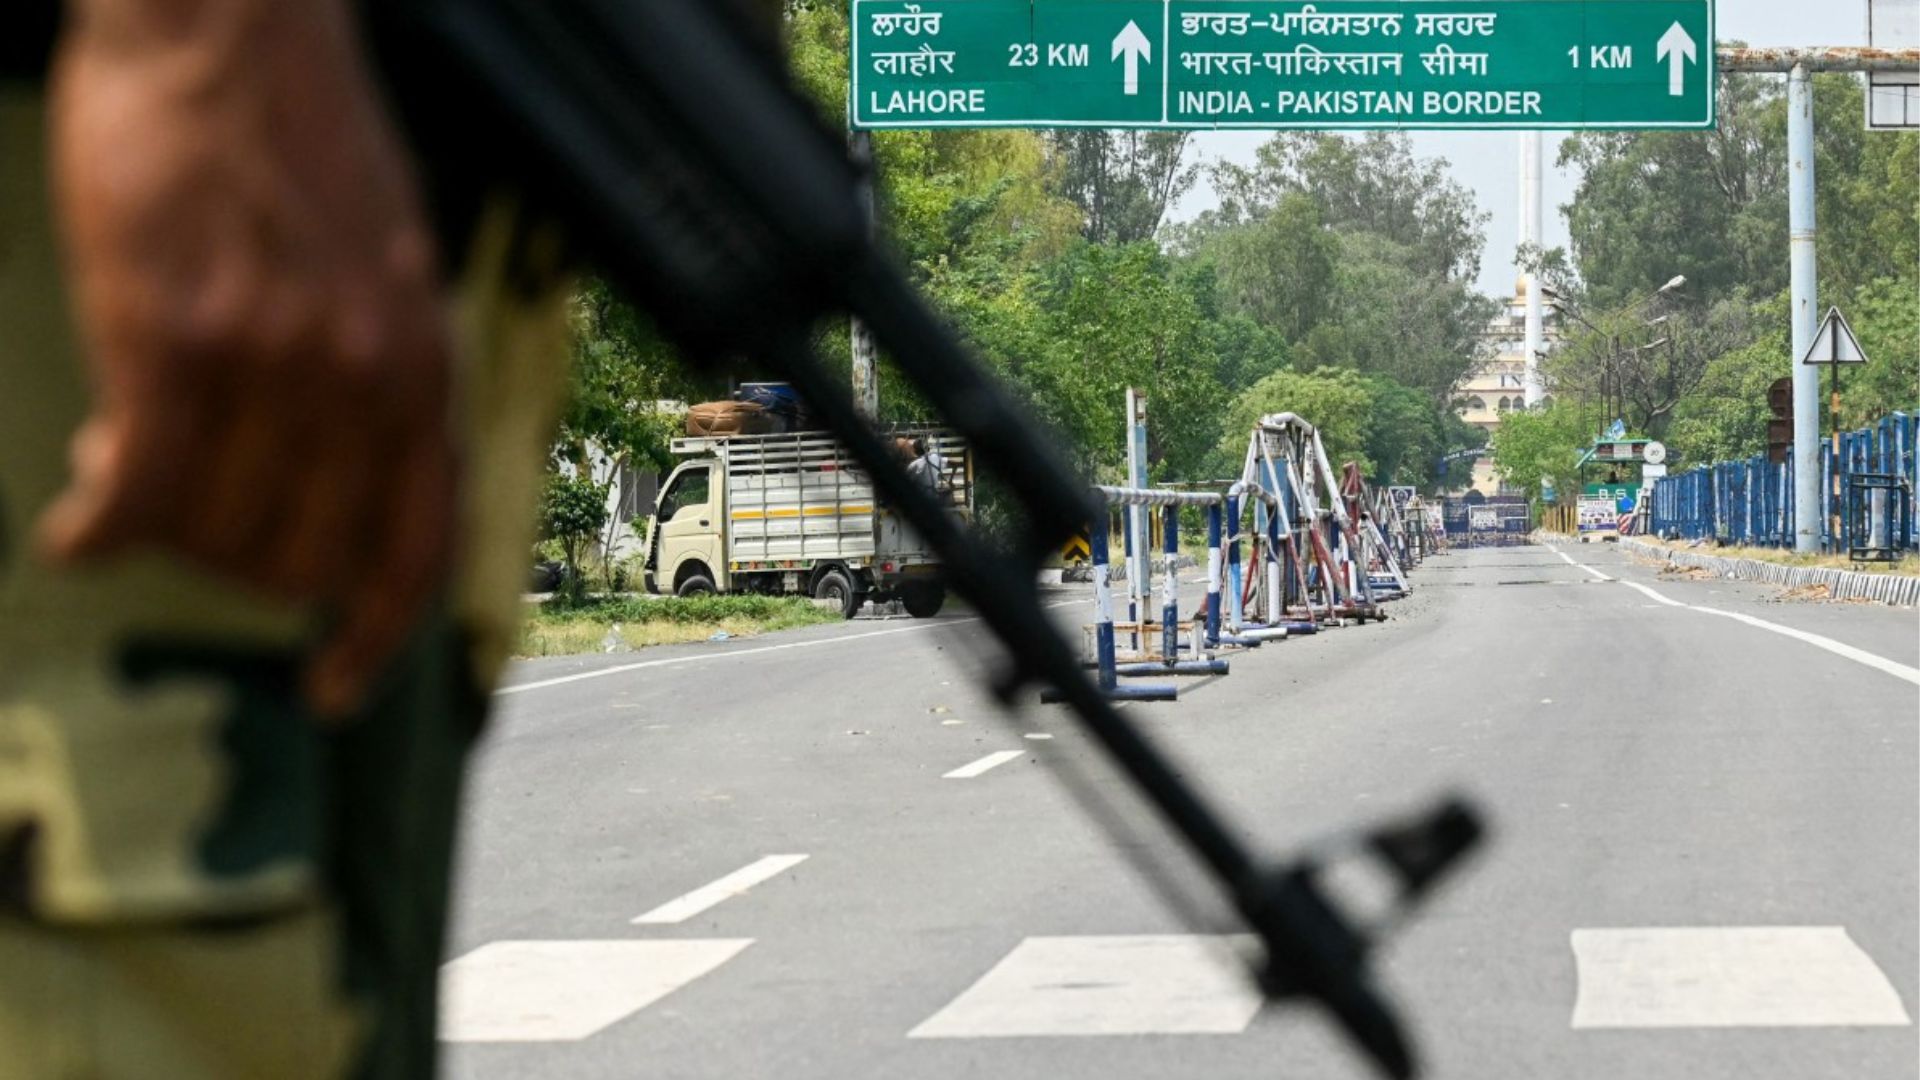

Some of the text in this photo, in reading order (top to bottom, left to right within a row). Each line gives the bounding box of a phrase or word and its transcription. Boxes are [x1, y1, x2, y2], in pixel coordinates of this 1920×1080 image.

[871, 3, 943, 36] ਲਾਹੌਰ
[1414, 12, 1497, 36] ਸਰਹਦ
[871, 42, 956, 77] लाहौर
[1008, 43, 1089, 67] 23 KM
[1180, 43, 1489, 76] भारत-पाकिस्तान सीमा
[1568, 45, 1632, 69] 1 KM
[871, 89, 985, 114] LAHORE
[1179, 90, 1254, 114] INDIA
[1278, 90, 1414, 114] PAKISTAN
[1423, 91, 1542, 115] BORDER
